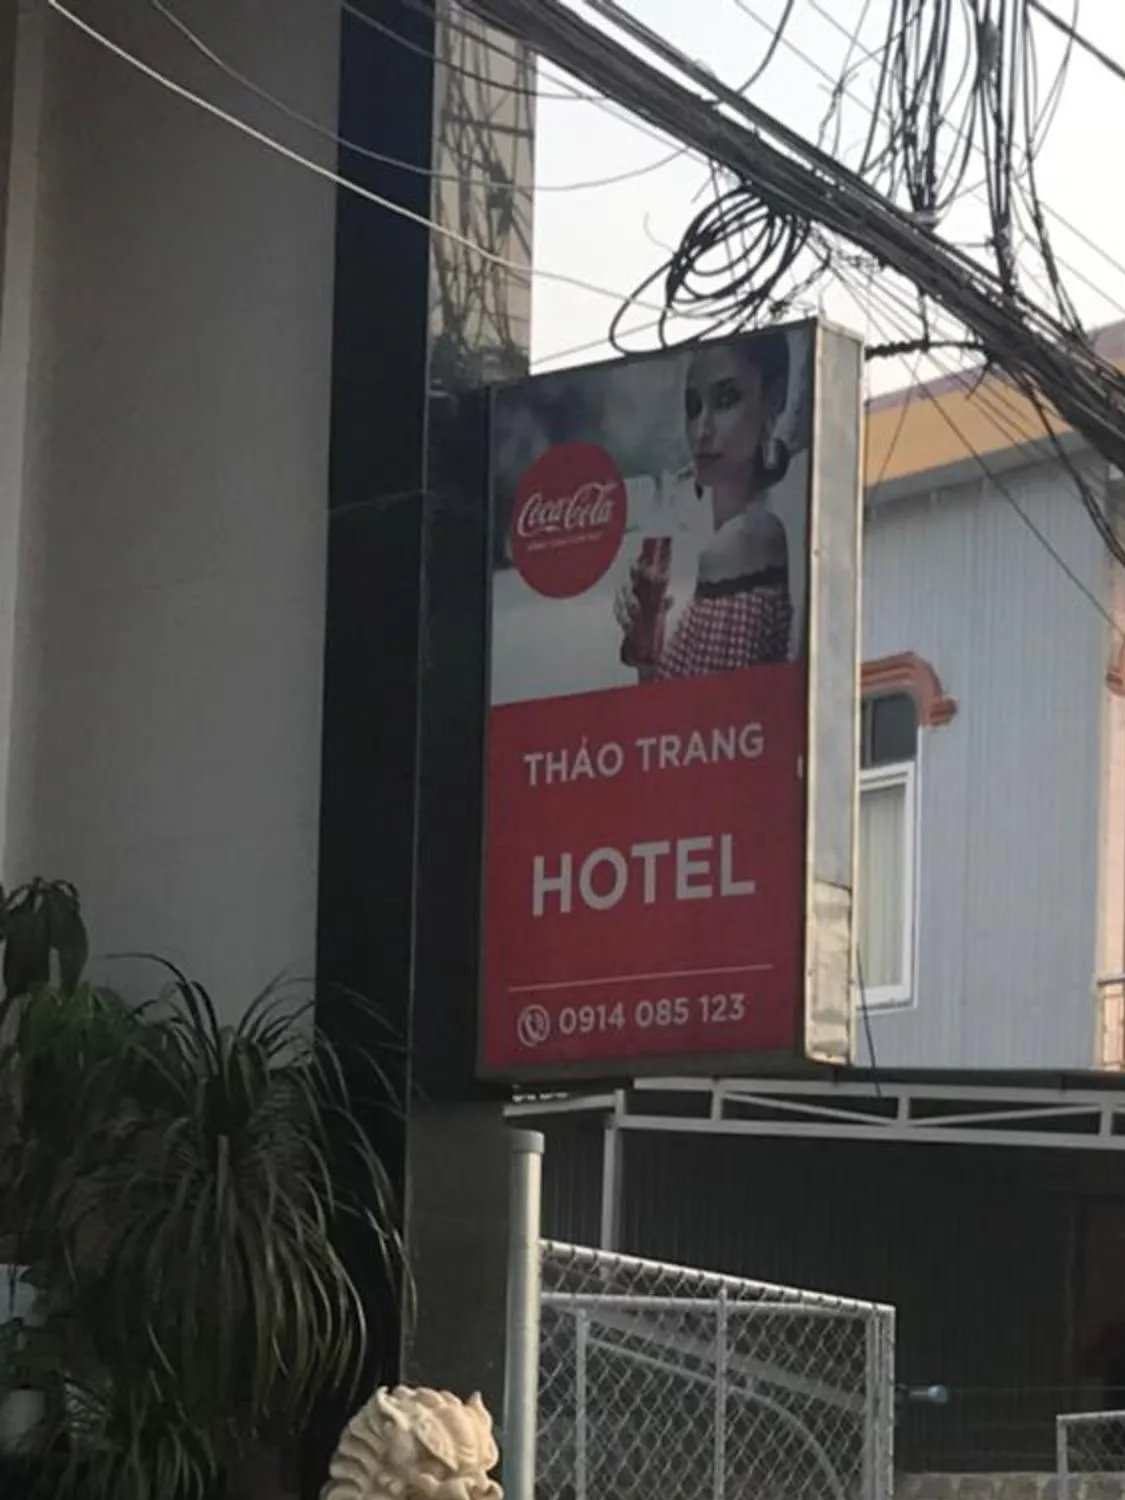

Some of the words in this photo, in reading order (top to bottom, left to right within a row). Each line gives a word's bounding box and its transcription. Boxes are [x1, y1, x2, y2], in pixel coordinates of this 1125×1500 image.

[523, 736, 625, 787] THẢO
[635, 722, 764, 772] TRANG
[531, 833, 755, 916] HOTEL
[559, 1003, 625, 1036] 0914
[635, 998, 690, 1028] 085
[699, 993, 745, 1023] 123
